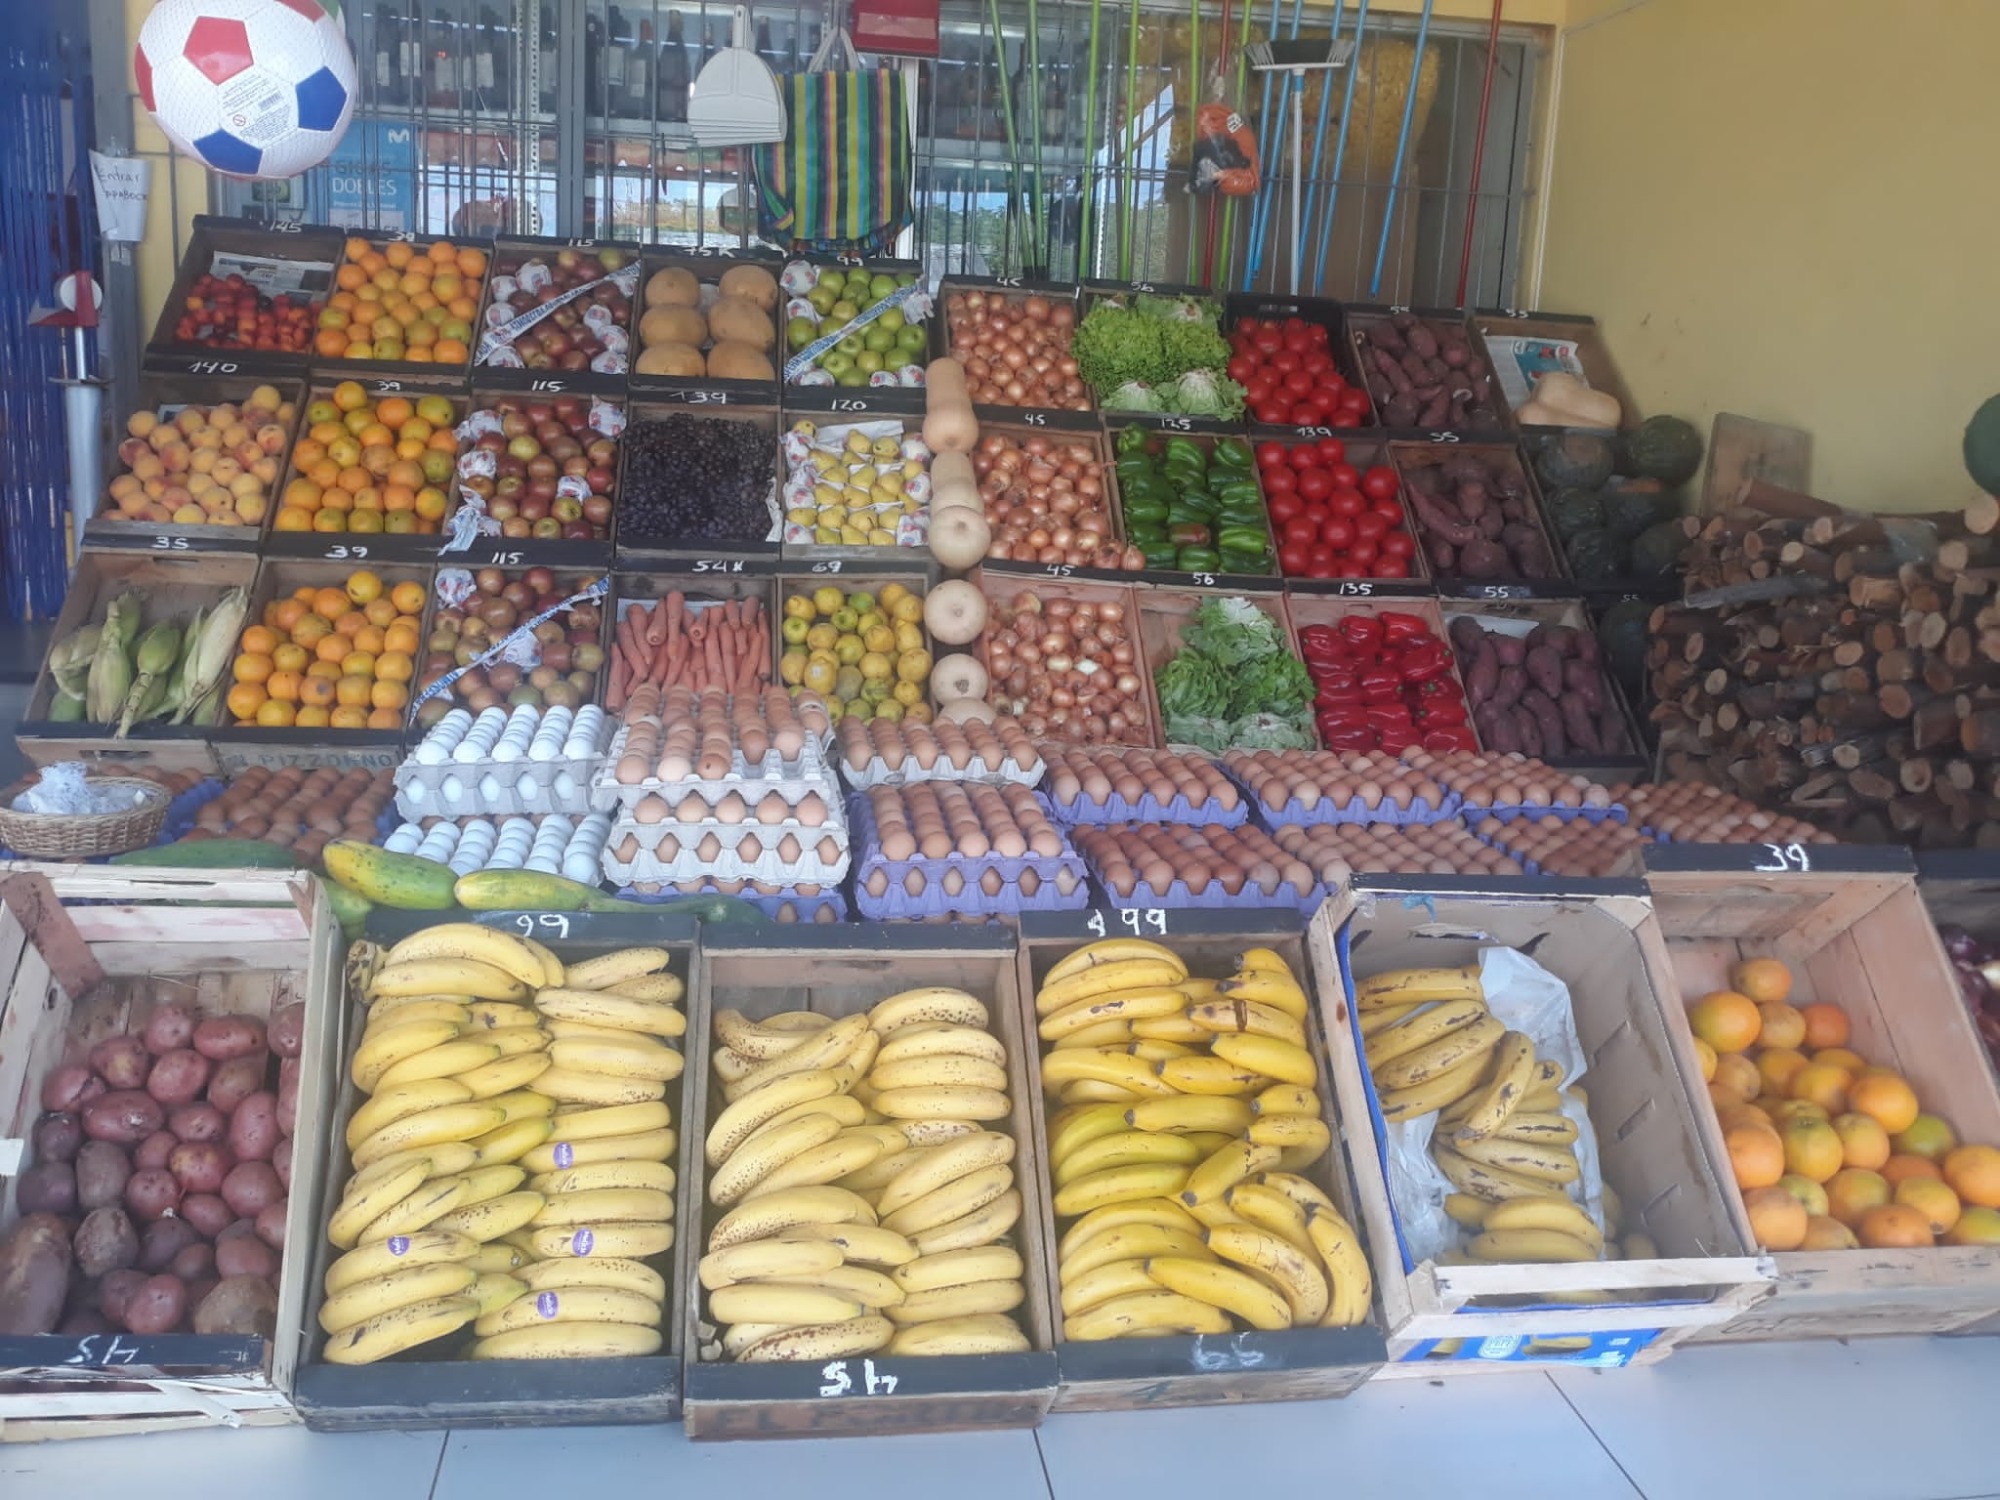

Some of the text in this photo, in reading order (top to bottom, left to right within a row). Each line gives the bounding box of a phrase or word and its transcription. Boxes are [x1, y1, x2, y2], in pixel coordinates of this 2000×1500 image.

[269, 220, 302, 233] 145
[388, 231, 415, 242] 39
[569, 238, 595, 247] 115
[836, 256, 864, 267] 99
[188, 361, 238, 373] 140
[378, 380, 401, 391] 39
[531, 381, 566, 391] 115
[831, 399, 867, 411] 120
[1024, 413, 1046, 425] 45
[1161, 418, 1192, 431] 125
[1296, 426, 1332, 437] 139
[1429, 431, 1460, 443] 55
[151, 536, 189, 549] 35
[325, 545, 368, 558] 39
[491, 552, 524, 564] 115
[812, 560, 842, 573] 69
[1046, 564, 1076, 576] 45
[1192, 573, 1215, 586] 56
[1339, 582, 1373, 595] 135
[1484, 585, 1509, 599] 55
[1751, 843, 1809, 872] 39
[516, 914, 569, 938] 99
[1121, 908, 1167, 936] 99
